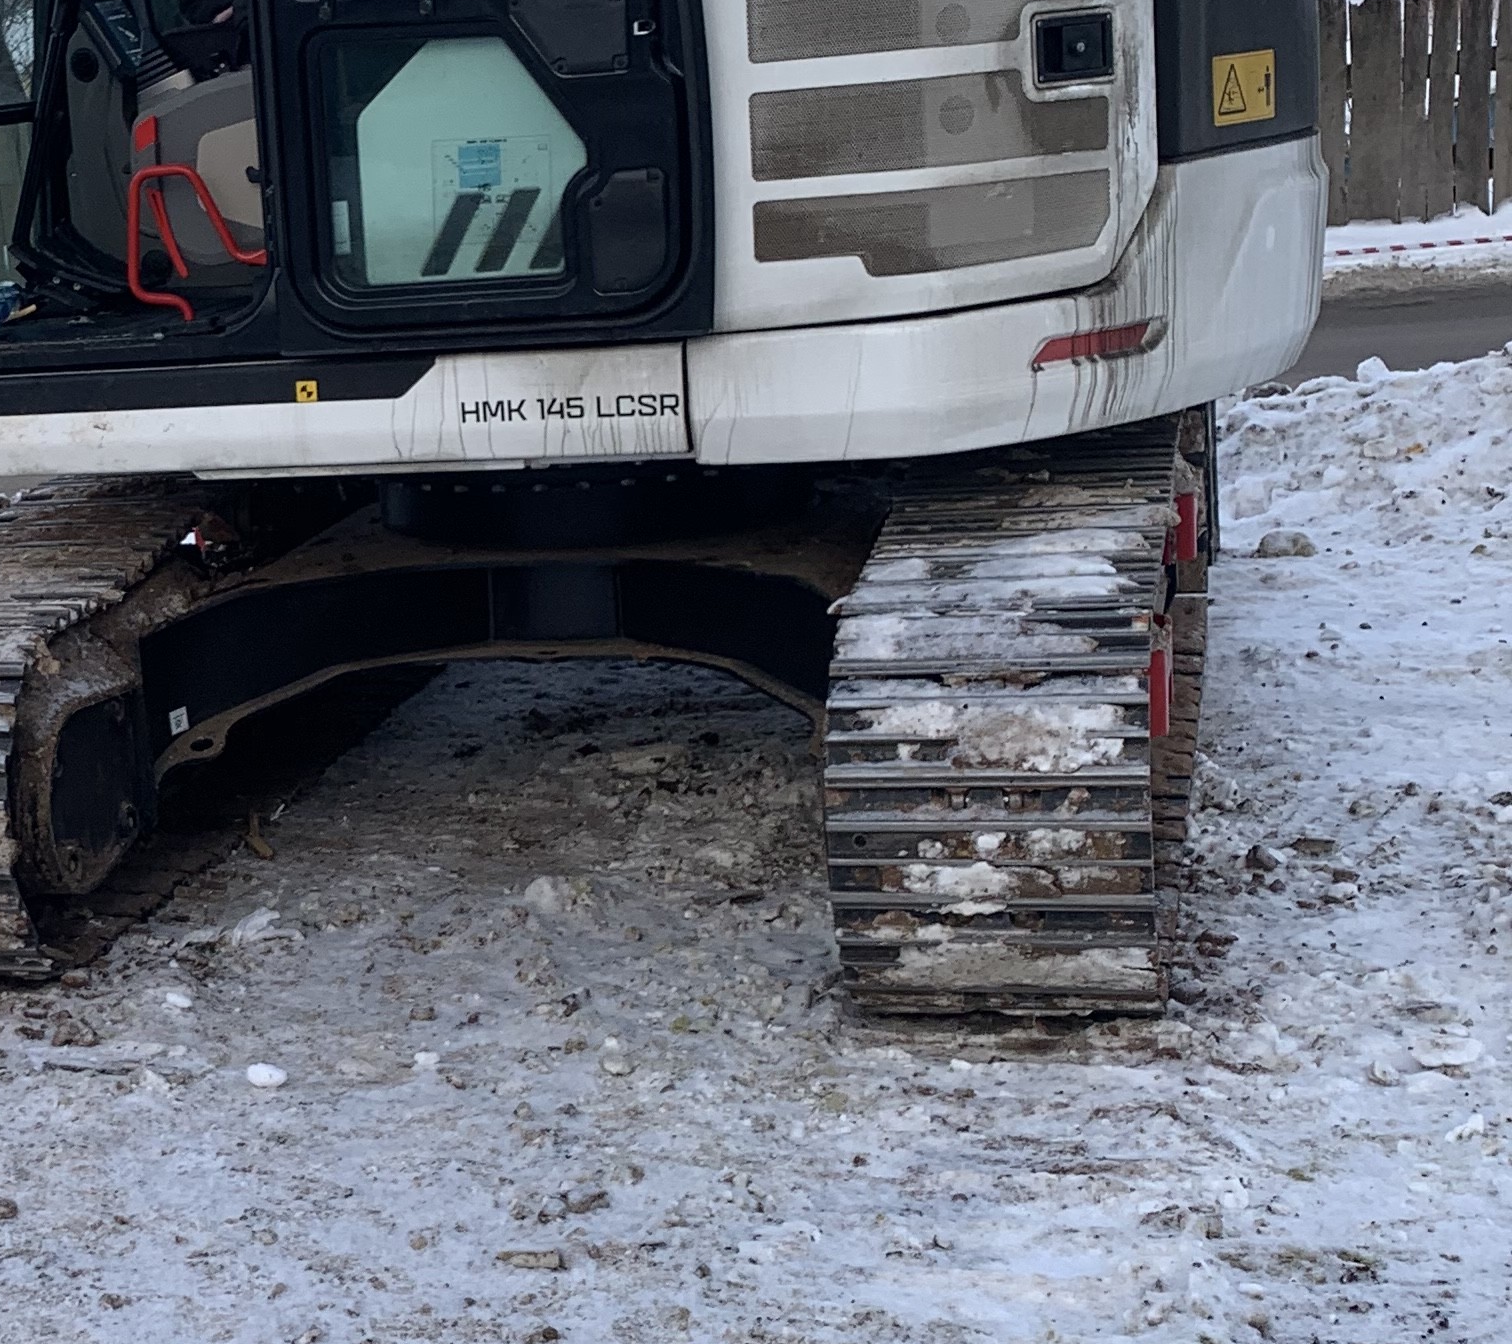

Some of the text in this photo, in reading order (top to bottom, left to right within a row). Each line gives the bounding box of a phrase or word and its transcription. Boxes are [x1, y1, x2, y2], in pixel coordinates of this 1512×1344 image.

[461, 394, 681, 423] HMK 145 LCSR
